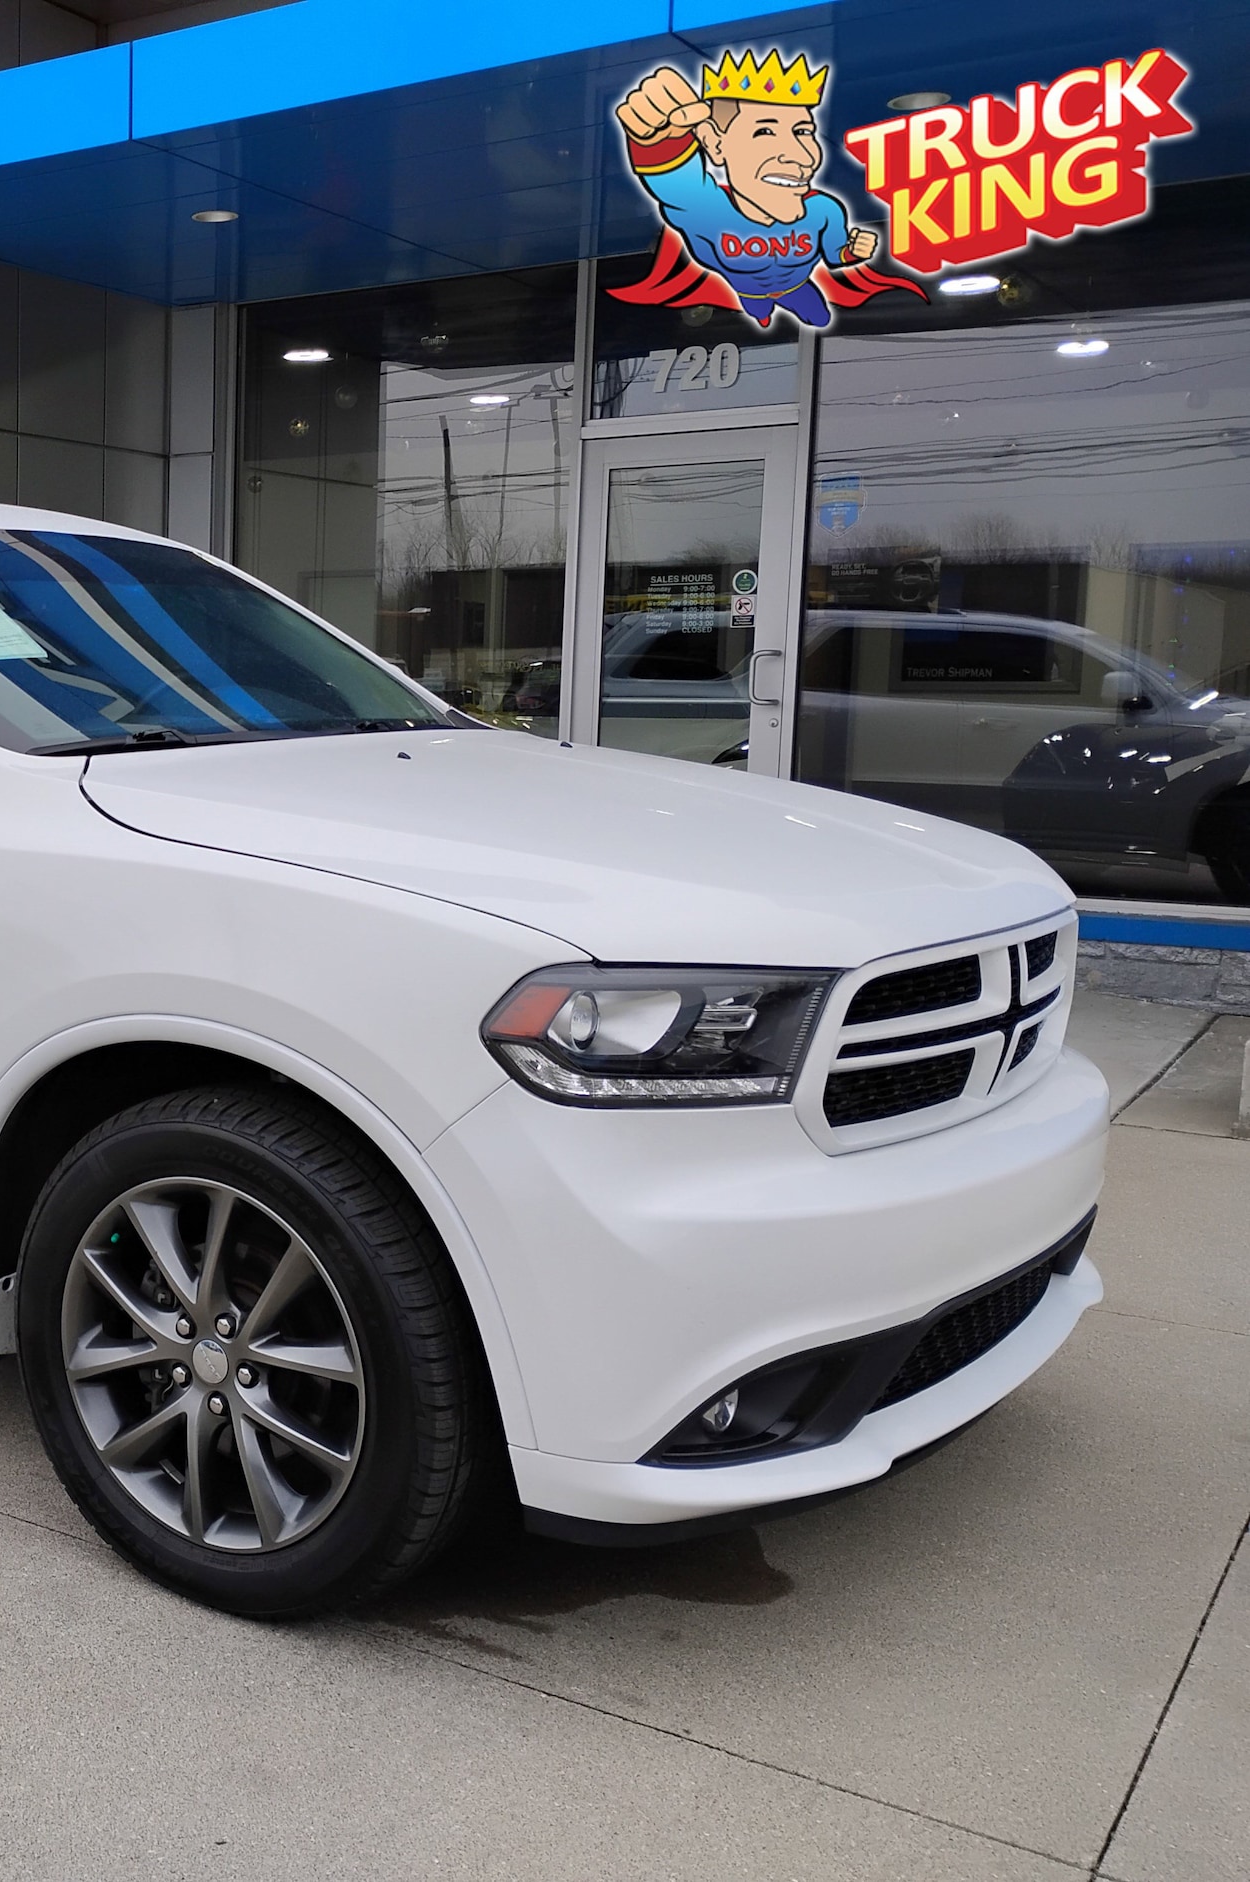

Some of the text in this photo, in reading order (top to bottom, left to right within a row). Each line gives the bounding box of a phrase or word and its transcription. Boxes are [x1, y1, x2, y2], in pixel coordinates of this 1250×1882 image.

[650, 343, 741, 394] 720
[650, 573, 713, 584] SALES HOURS
[681, 625, 712, 633] CLOSED
[906, 666, 993, 678] TREVOR SHIPMAN
